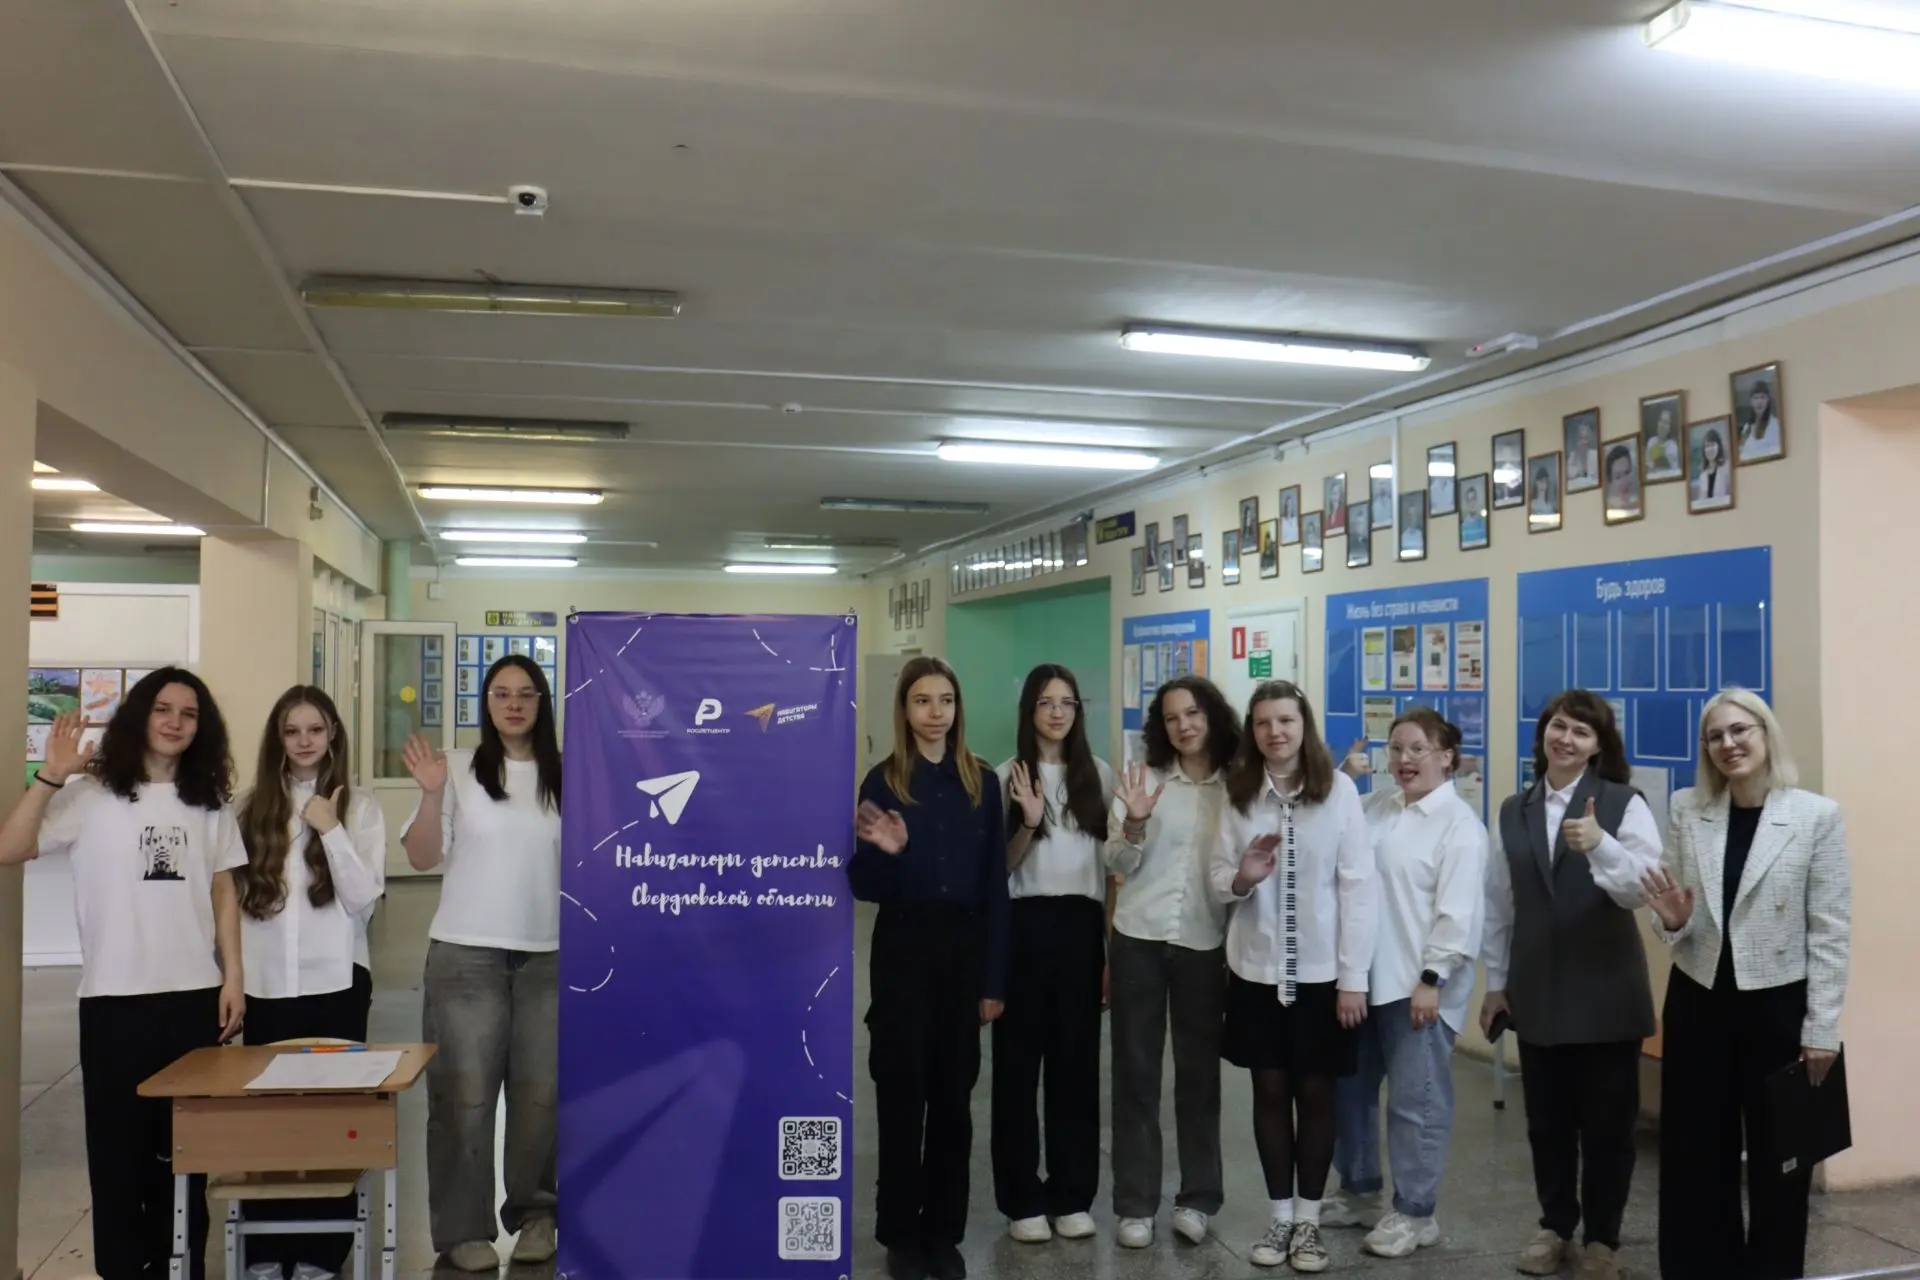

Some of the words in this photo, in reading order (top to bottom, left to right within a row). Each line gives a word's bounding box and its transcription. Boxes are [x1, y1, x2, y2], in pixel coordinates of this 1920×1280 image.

[1596, 577, 1622, 603] Будь
[1624, 578, 1666, 600] здоров
[776, 704, 818, 716] НАВИГАТОРЫ
[777, 713, 806, 725] ДЕТСТВА
[750, 843, 843, 878] детства
[631, 882, 752, 916] Свердловской
[756, 888, 837, 908] области
